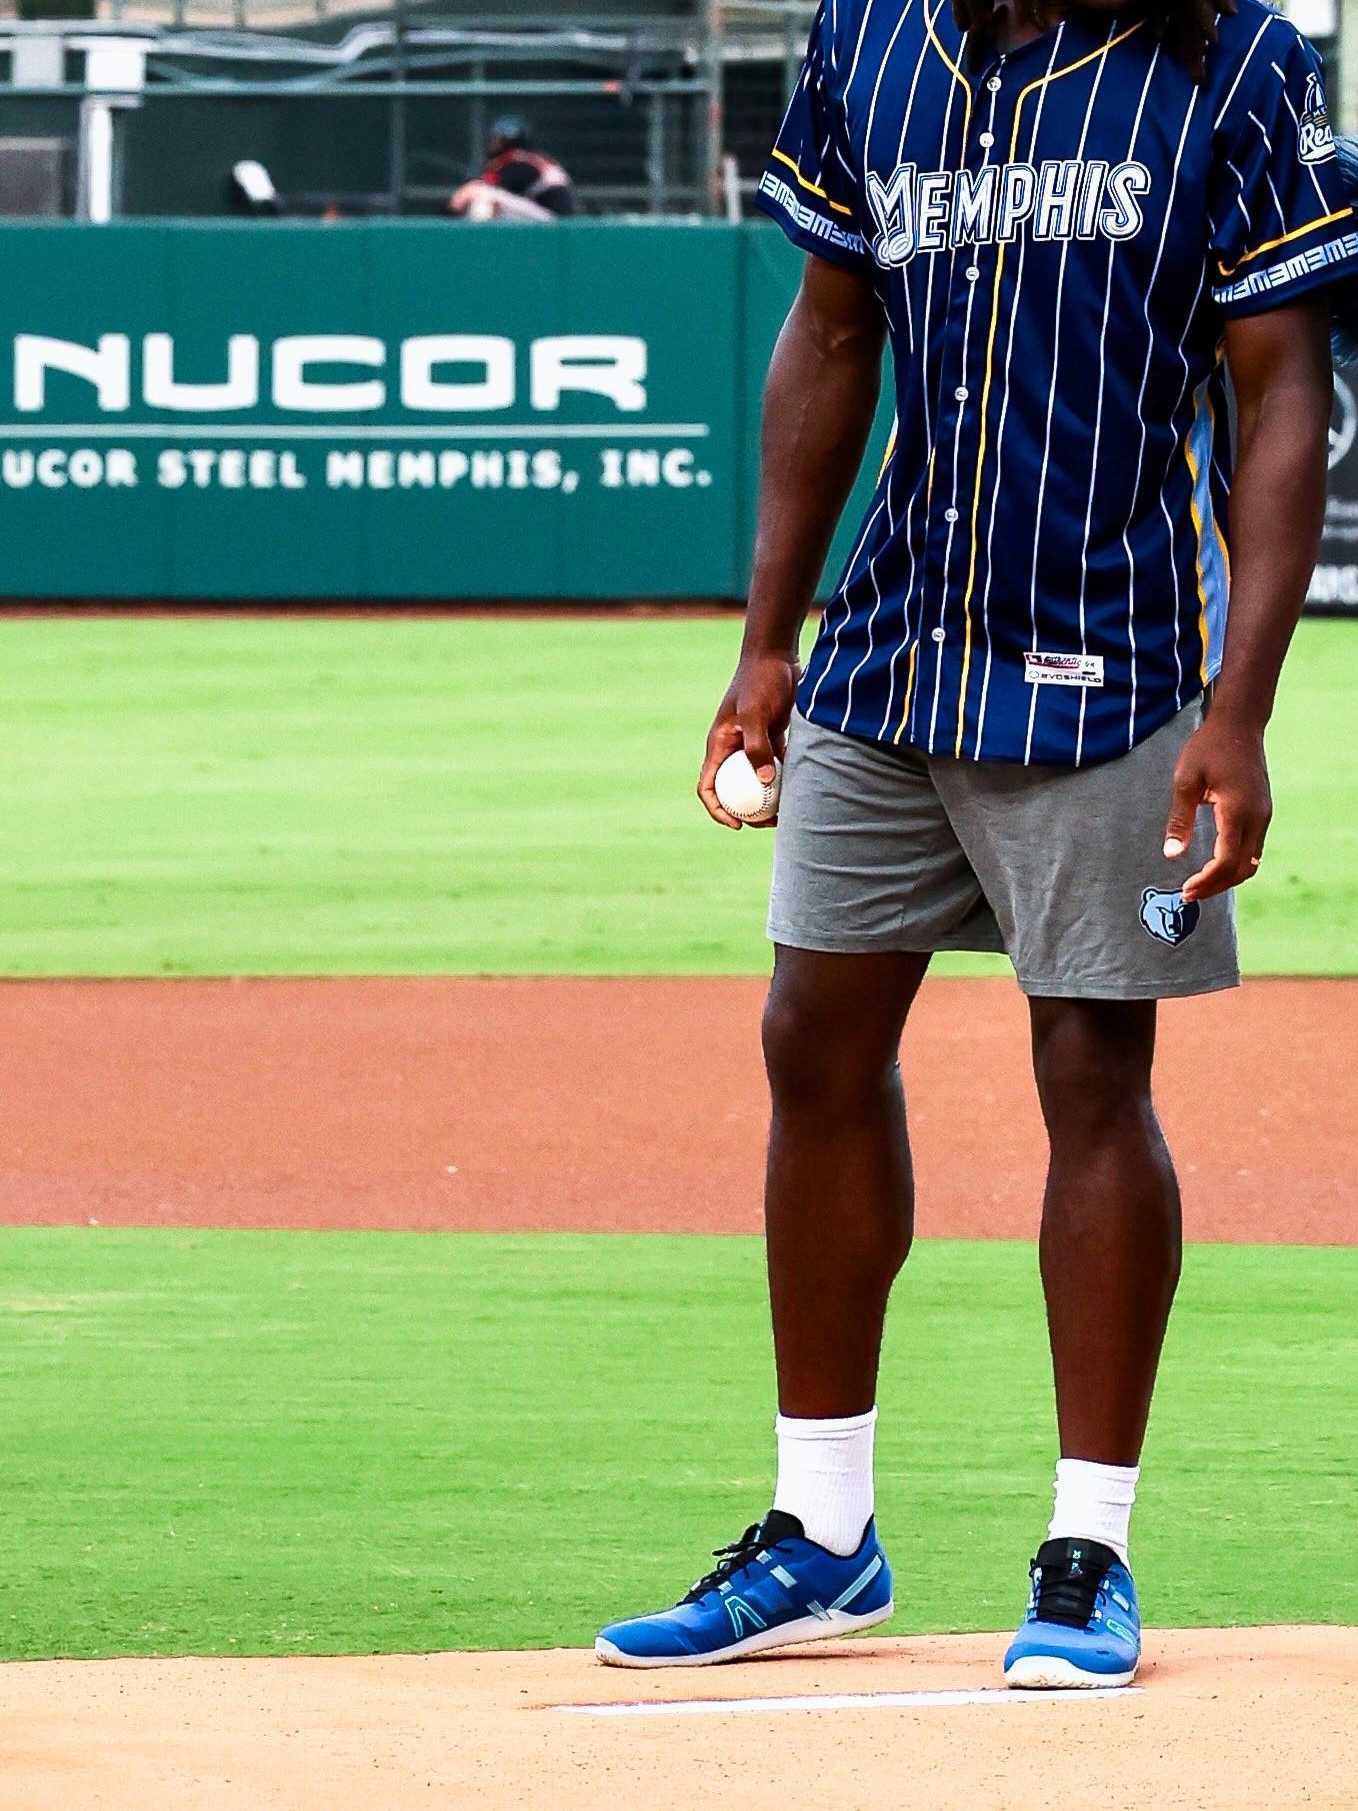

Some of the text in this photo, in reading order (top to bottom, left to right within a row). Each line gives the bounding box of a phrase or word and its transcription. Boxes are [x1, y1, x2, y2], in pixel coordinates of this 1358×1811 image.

[866, 161, 1151, 267] MEMPHIS
[13, 333, 647, 411] NUCOR
[158, 449, 305, 488] STEEL
[326, 449, 578, 492] MEMPHIS,
[601, 448, 712, 487] INC.
